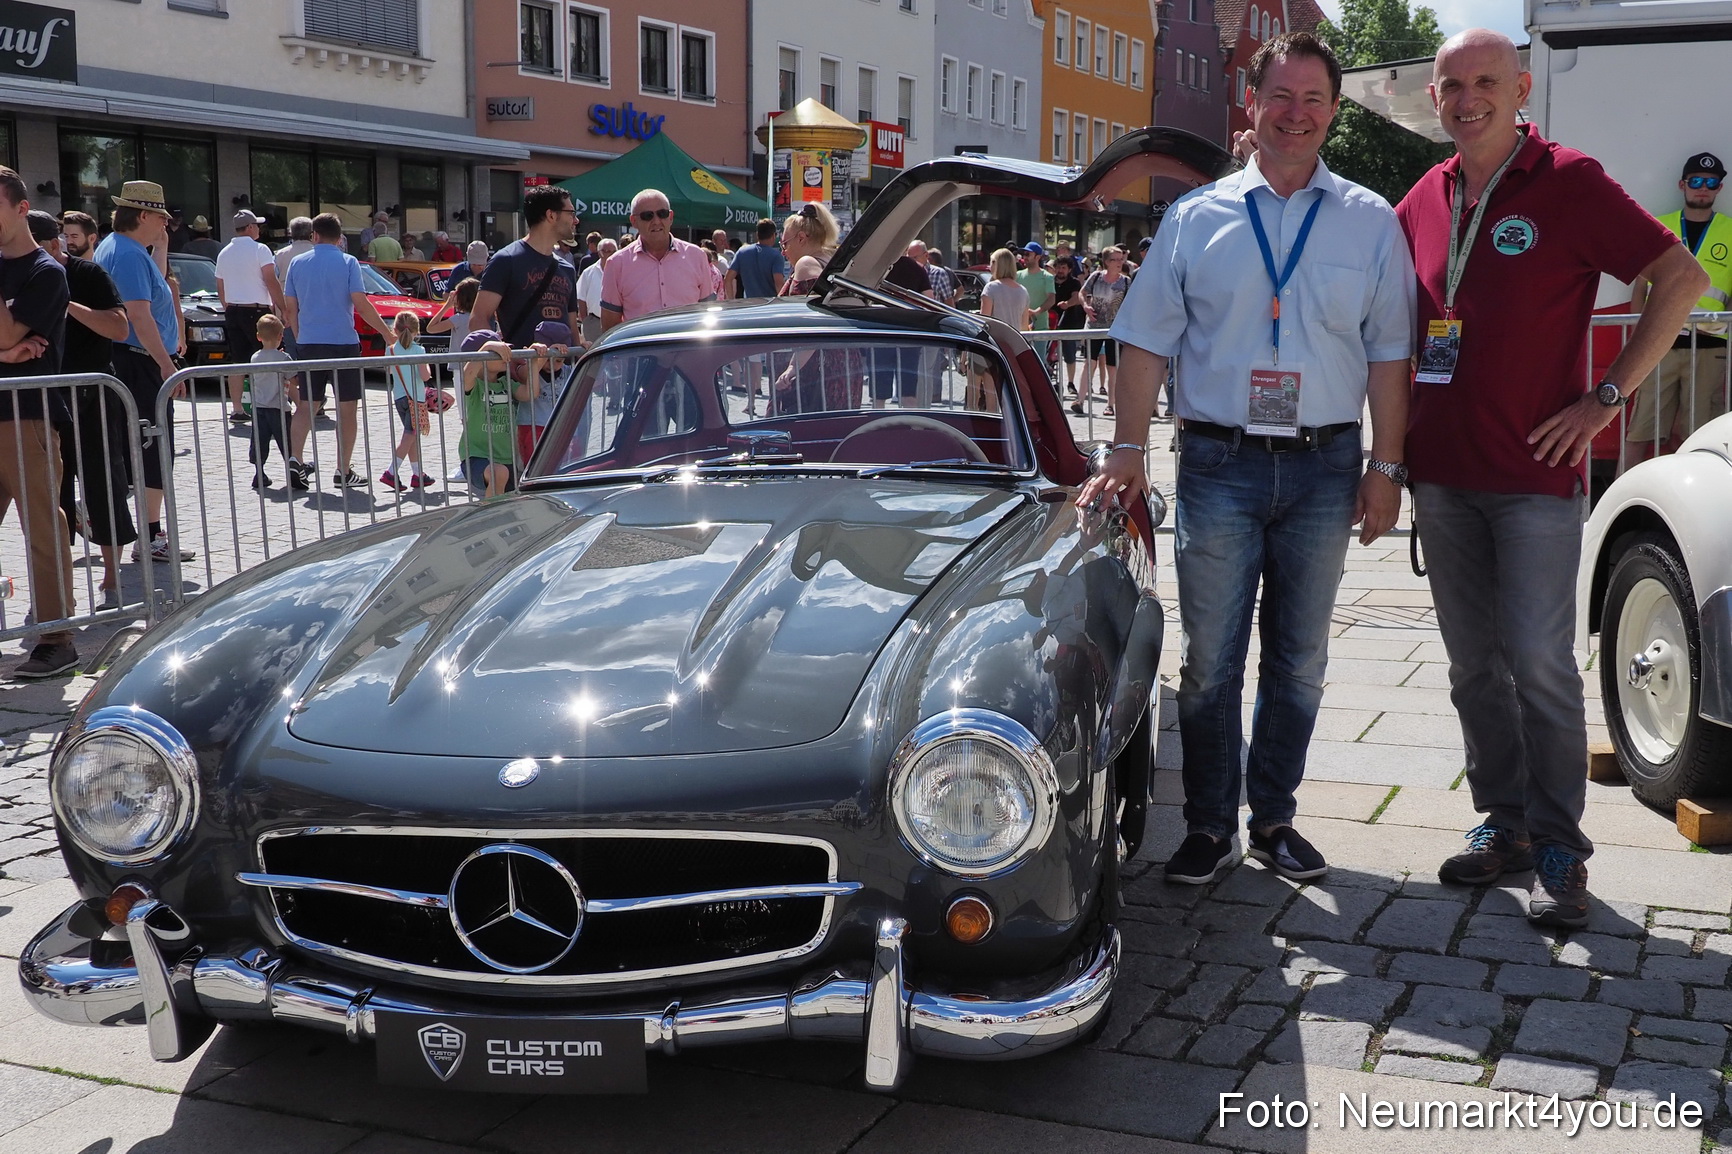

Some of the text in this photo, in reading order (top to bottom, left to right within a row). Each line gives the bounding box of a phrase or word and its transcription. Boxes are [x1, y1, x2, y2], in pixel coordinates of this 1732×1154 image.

[877, 129, 903, 153] WITT
[592, 201, 632, 215] DEKRA
[735, 209, 759, 224] DEKRA
[424, 1031, 461, 1049] CB
[487, 1039, 602, 1056] CUSTOM
[487, 1059, 564, 1076] CARS
